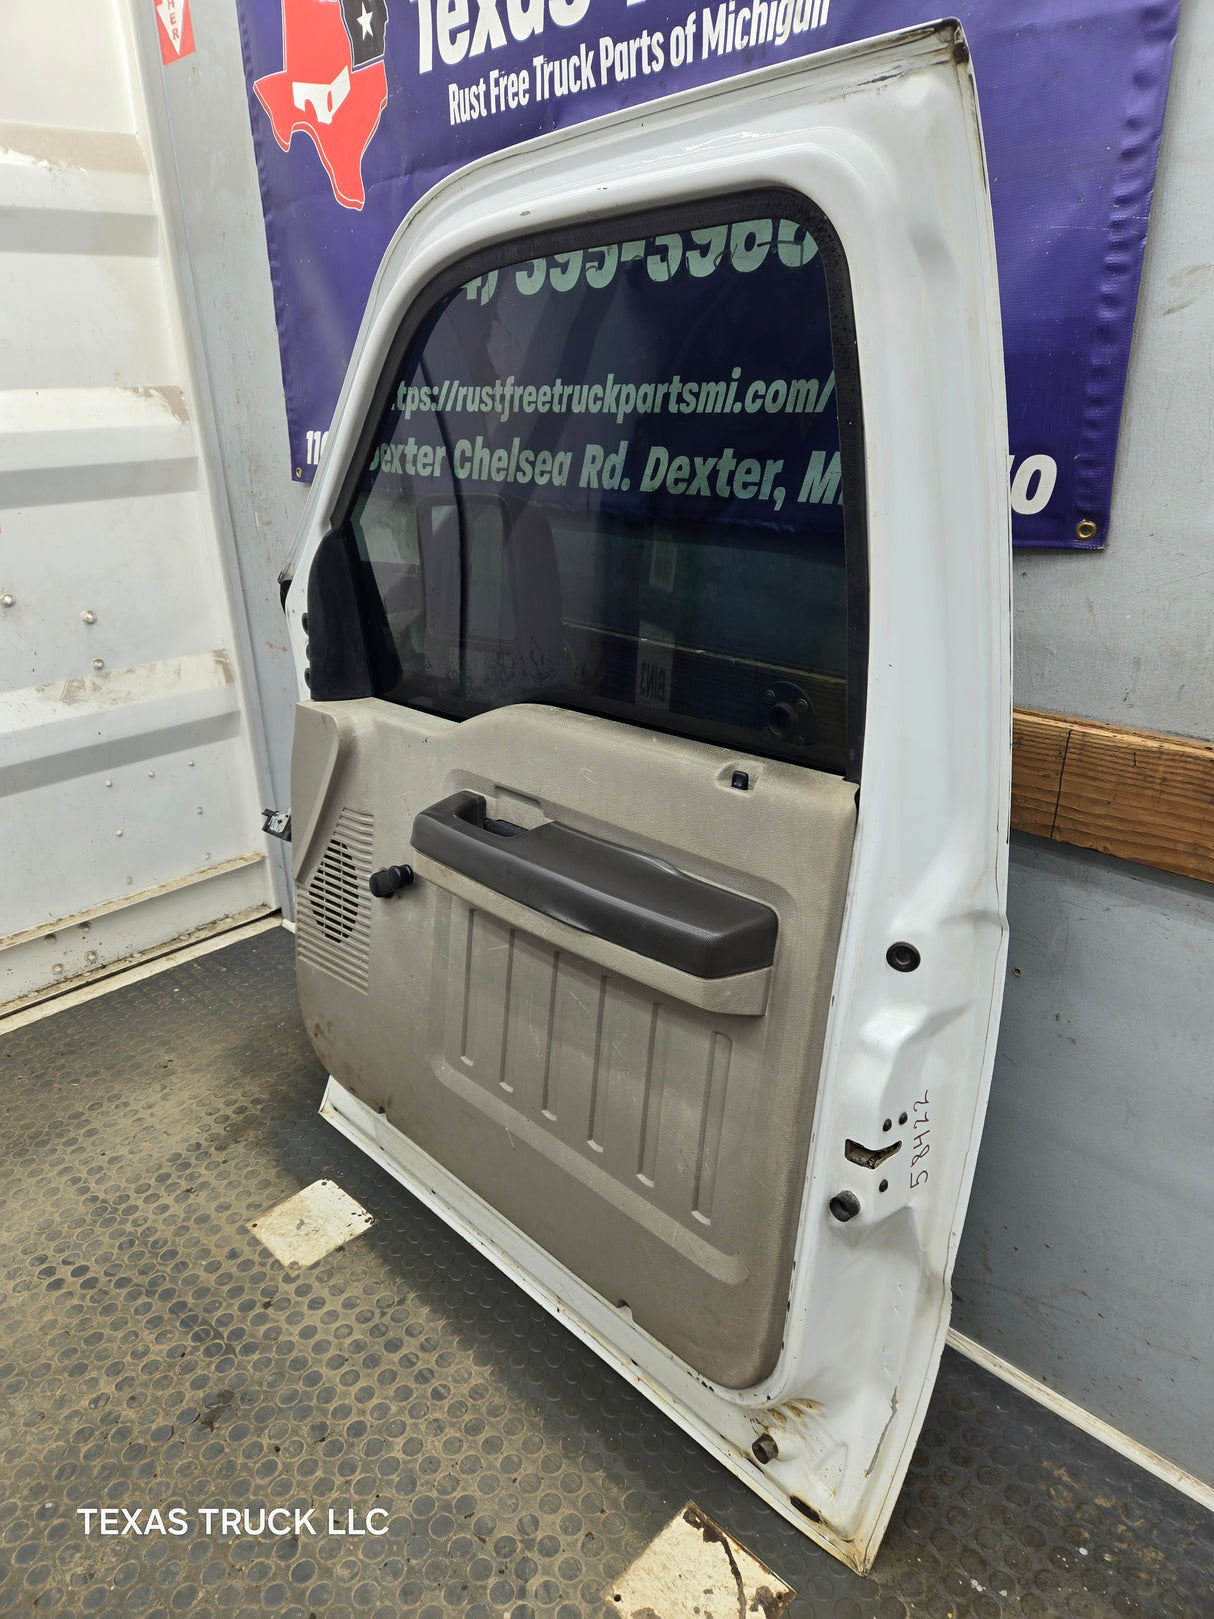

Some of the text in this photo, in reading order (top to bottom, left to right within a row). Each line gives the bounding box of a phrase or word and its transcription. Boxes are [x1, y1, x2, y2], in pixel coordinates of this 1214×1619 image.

[448, 0, 830, 126] Rust Free Truck Parts of Michigan
[391, 366, 835, 424] tps://rustfreetruckpartsmi.com/
[453, 436, 572, 486] Chelsea
[579, 440, 631, 491] Rd.
[639, 446, 787, 511] Dexter,
[797, 450, 843, 505] M
[910, 1090, 930, 1189] 58422
